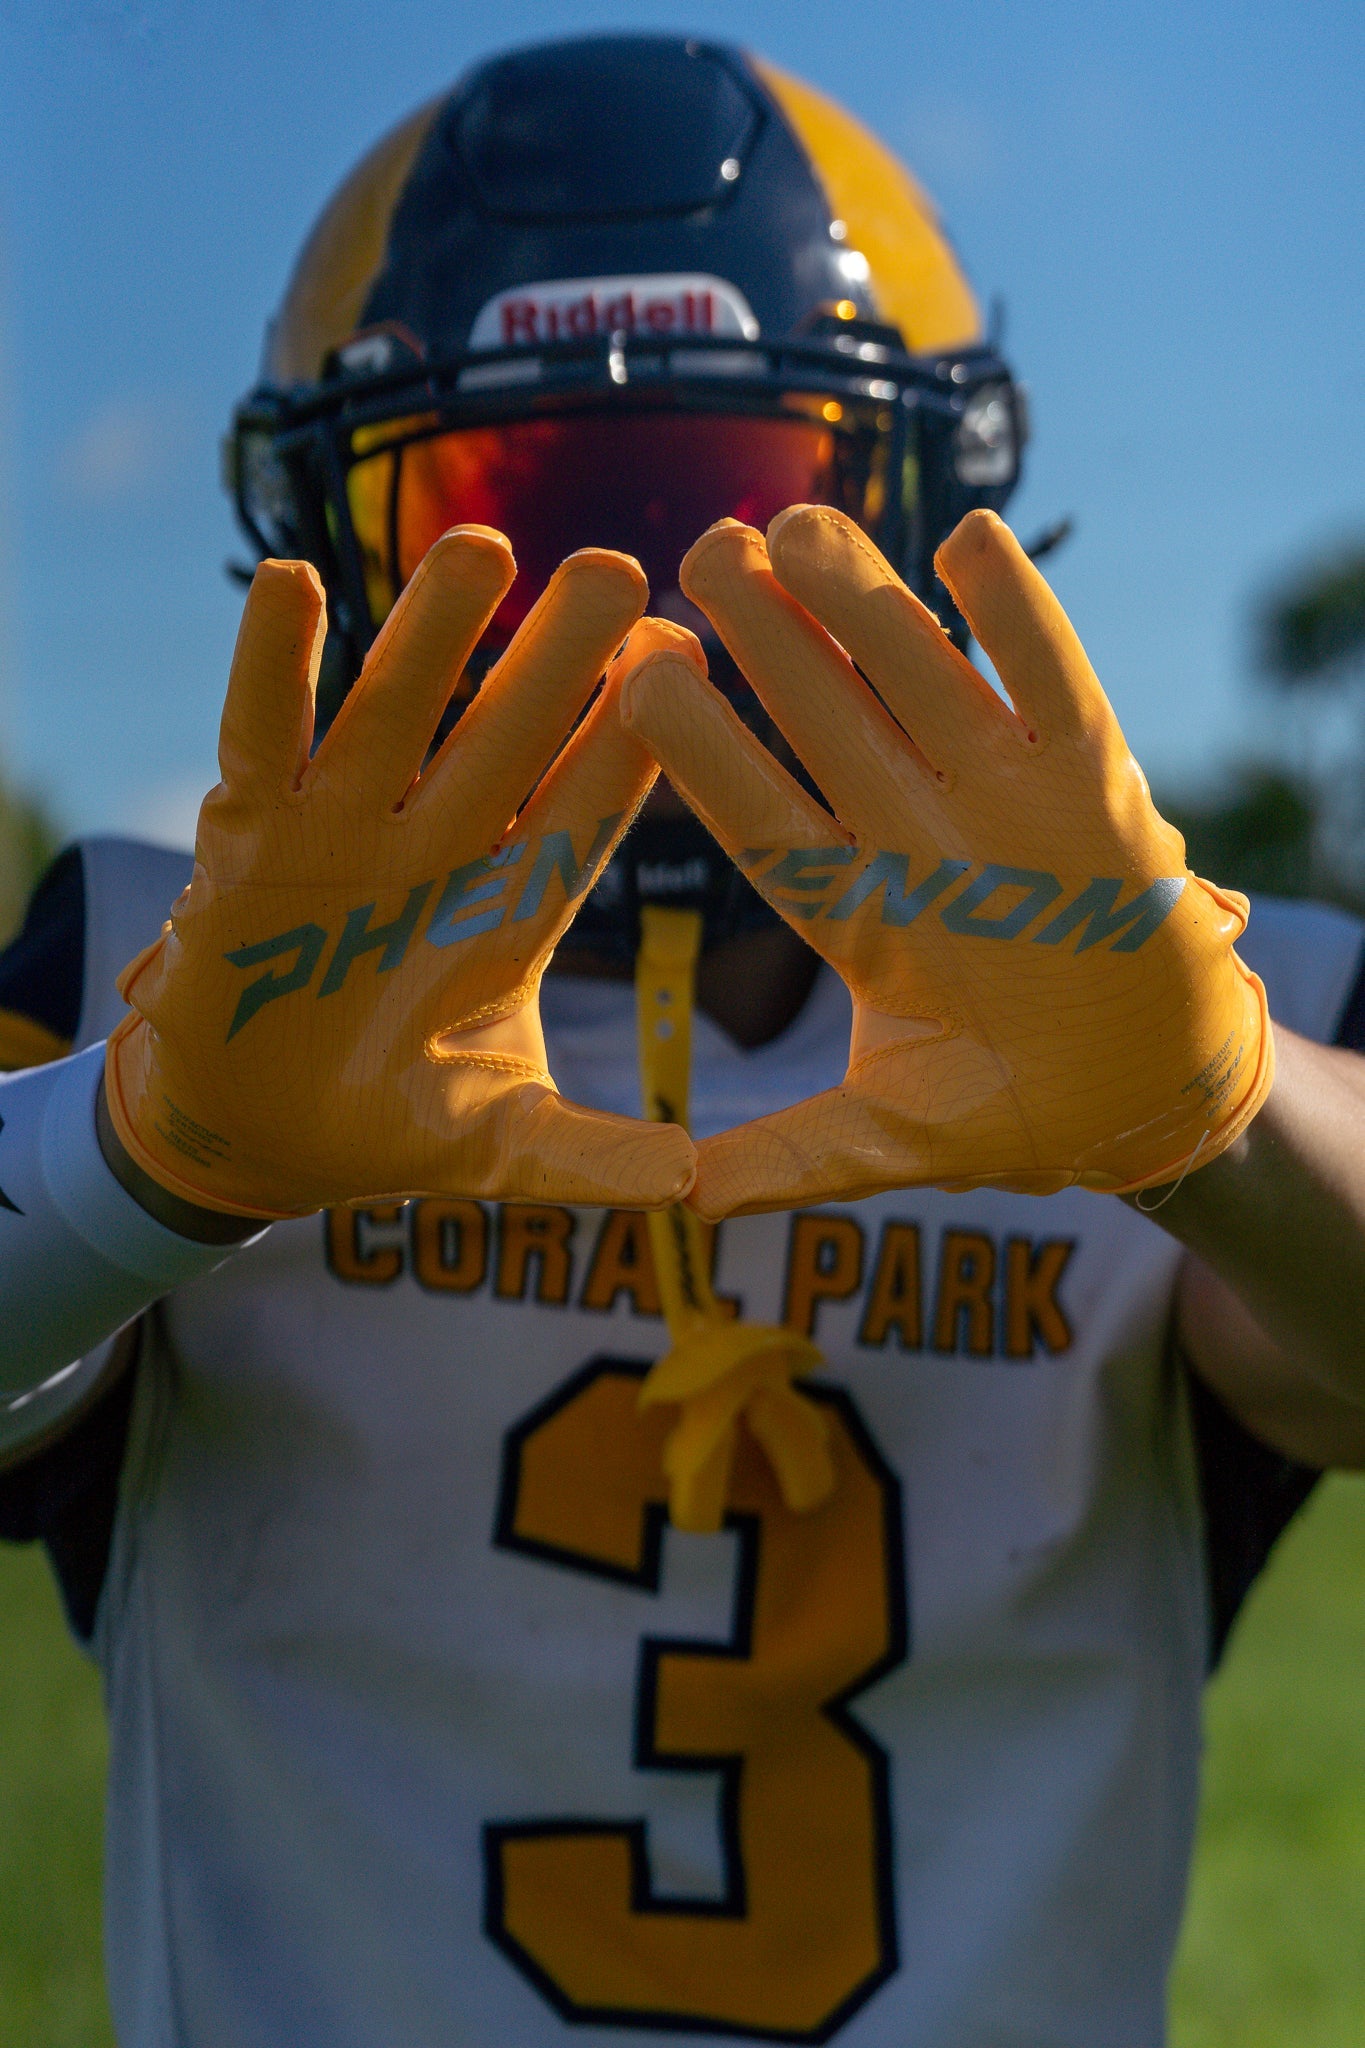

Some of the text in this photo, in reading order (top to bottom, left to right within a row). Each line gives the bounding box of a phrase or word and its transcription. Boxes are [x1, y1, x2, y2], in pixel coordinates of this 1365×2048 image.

[502, 289, 715, 346] Riddell
[222, 810, 627, 1046] PHEN
[783, 1210, 1075, 1361] PARK
[484, 1353, 908, 2046] 3
